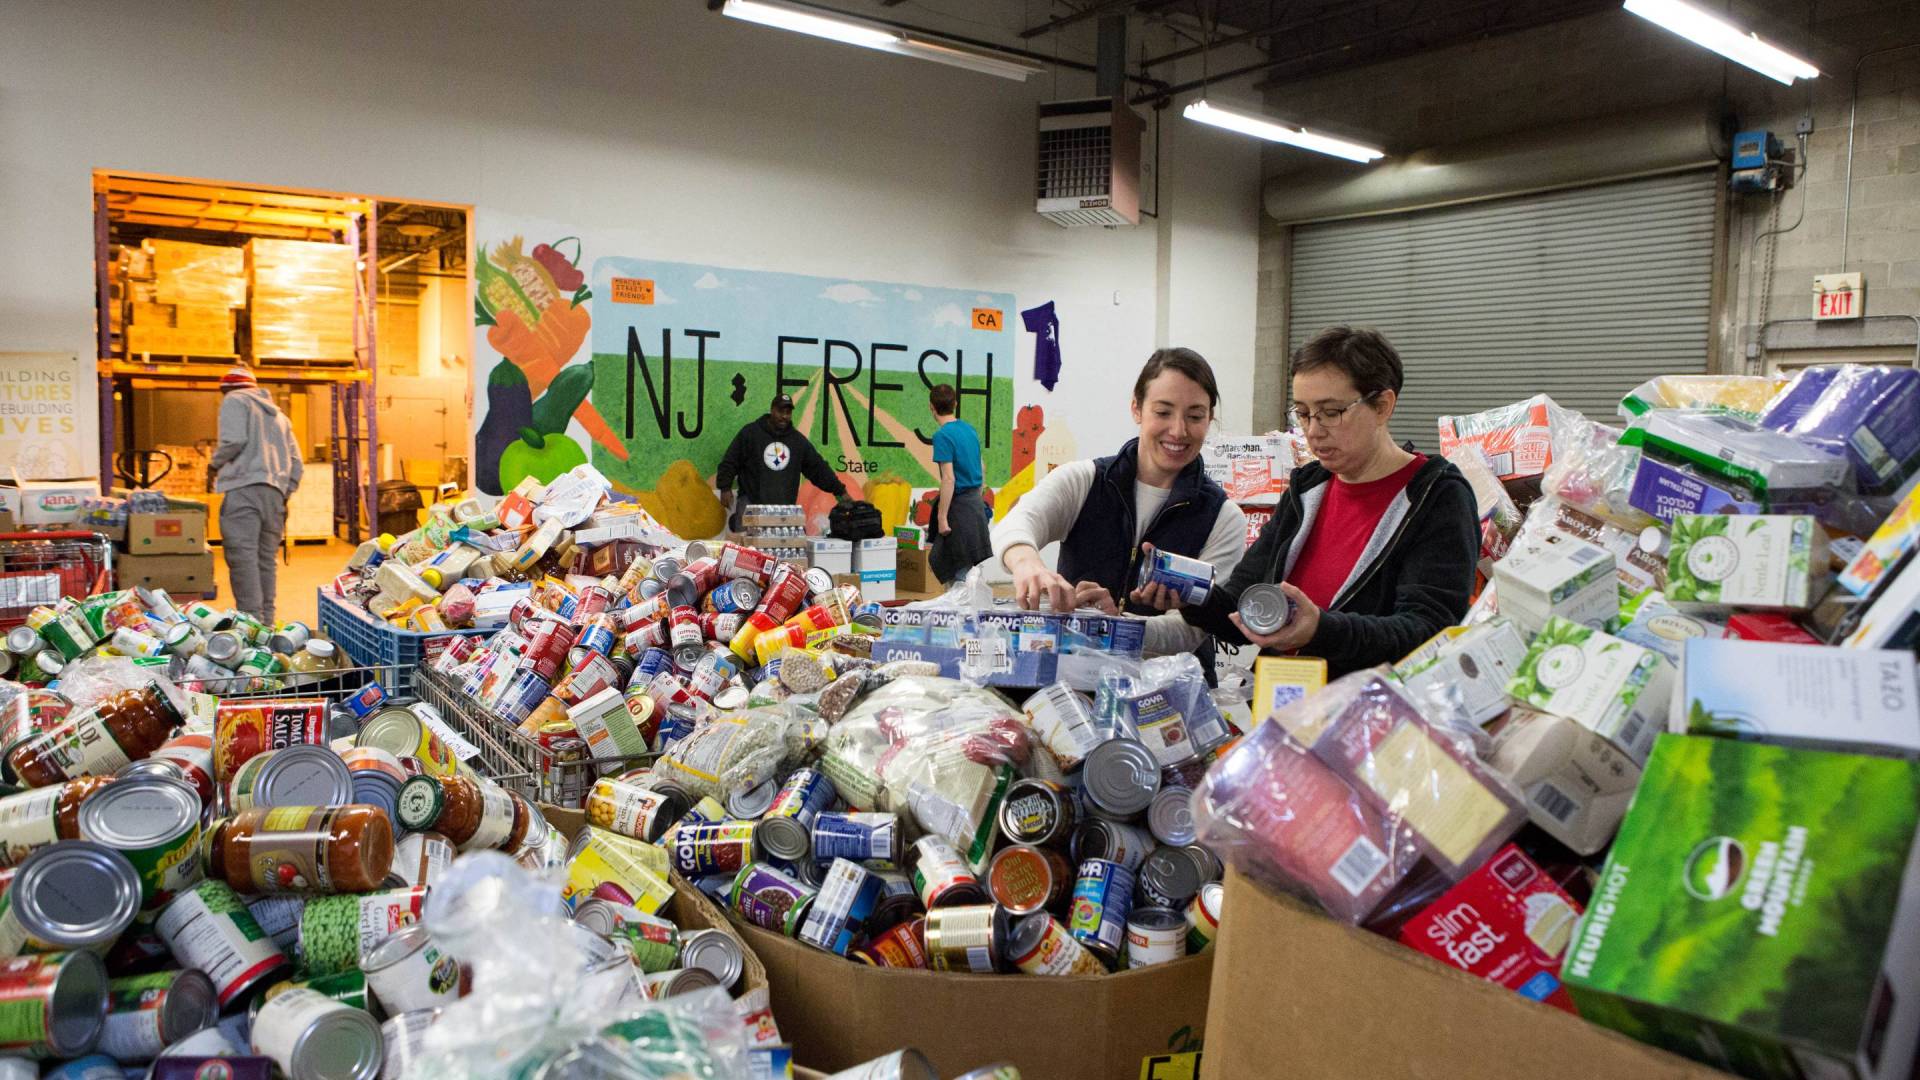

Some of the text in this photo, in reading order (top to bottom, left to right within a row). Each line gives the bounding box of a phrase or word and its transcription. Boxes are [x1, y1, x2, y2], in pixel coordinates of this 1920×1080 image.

[615, 291, 646, 300] FRIENDS
[1819, 292, 1852, 316] EXIT
[977, 313, 996, 327] CA
[625, 325, 994, 448] NJ FRESH
[836, 455, 879, 474] State
[1656, 495, 1695, 509] O'CLOCK
[1753, 561, 1769, 599] Nettle
[1023, 615, 1045, 624] GOYA
[1879, 661, 1905, 712] TAZO
[1137, 694, 1164, 708] GOYA
[1003, 855, 1021, 868] Our
[1003, 862, 1033, 882] Secret
[1007, 871, 1039, 891] Family
[1741, 841, 1779, 910] GREEN
[1757, 825, 1808, 936] MOUNTAIN
[1427, 902, 1481, 946] slim
[1571, 863, 1630, 979] KEURIG HOT
[1446, 921, 1507, 970] fast
